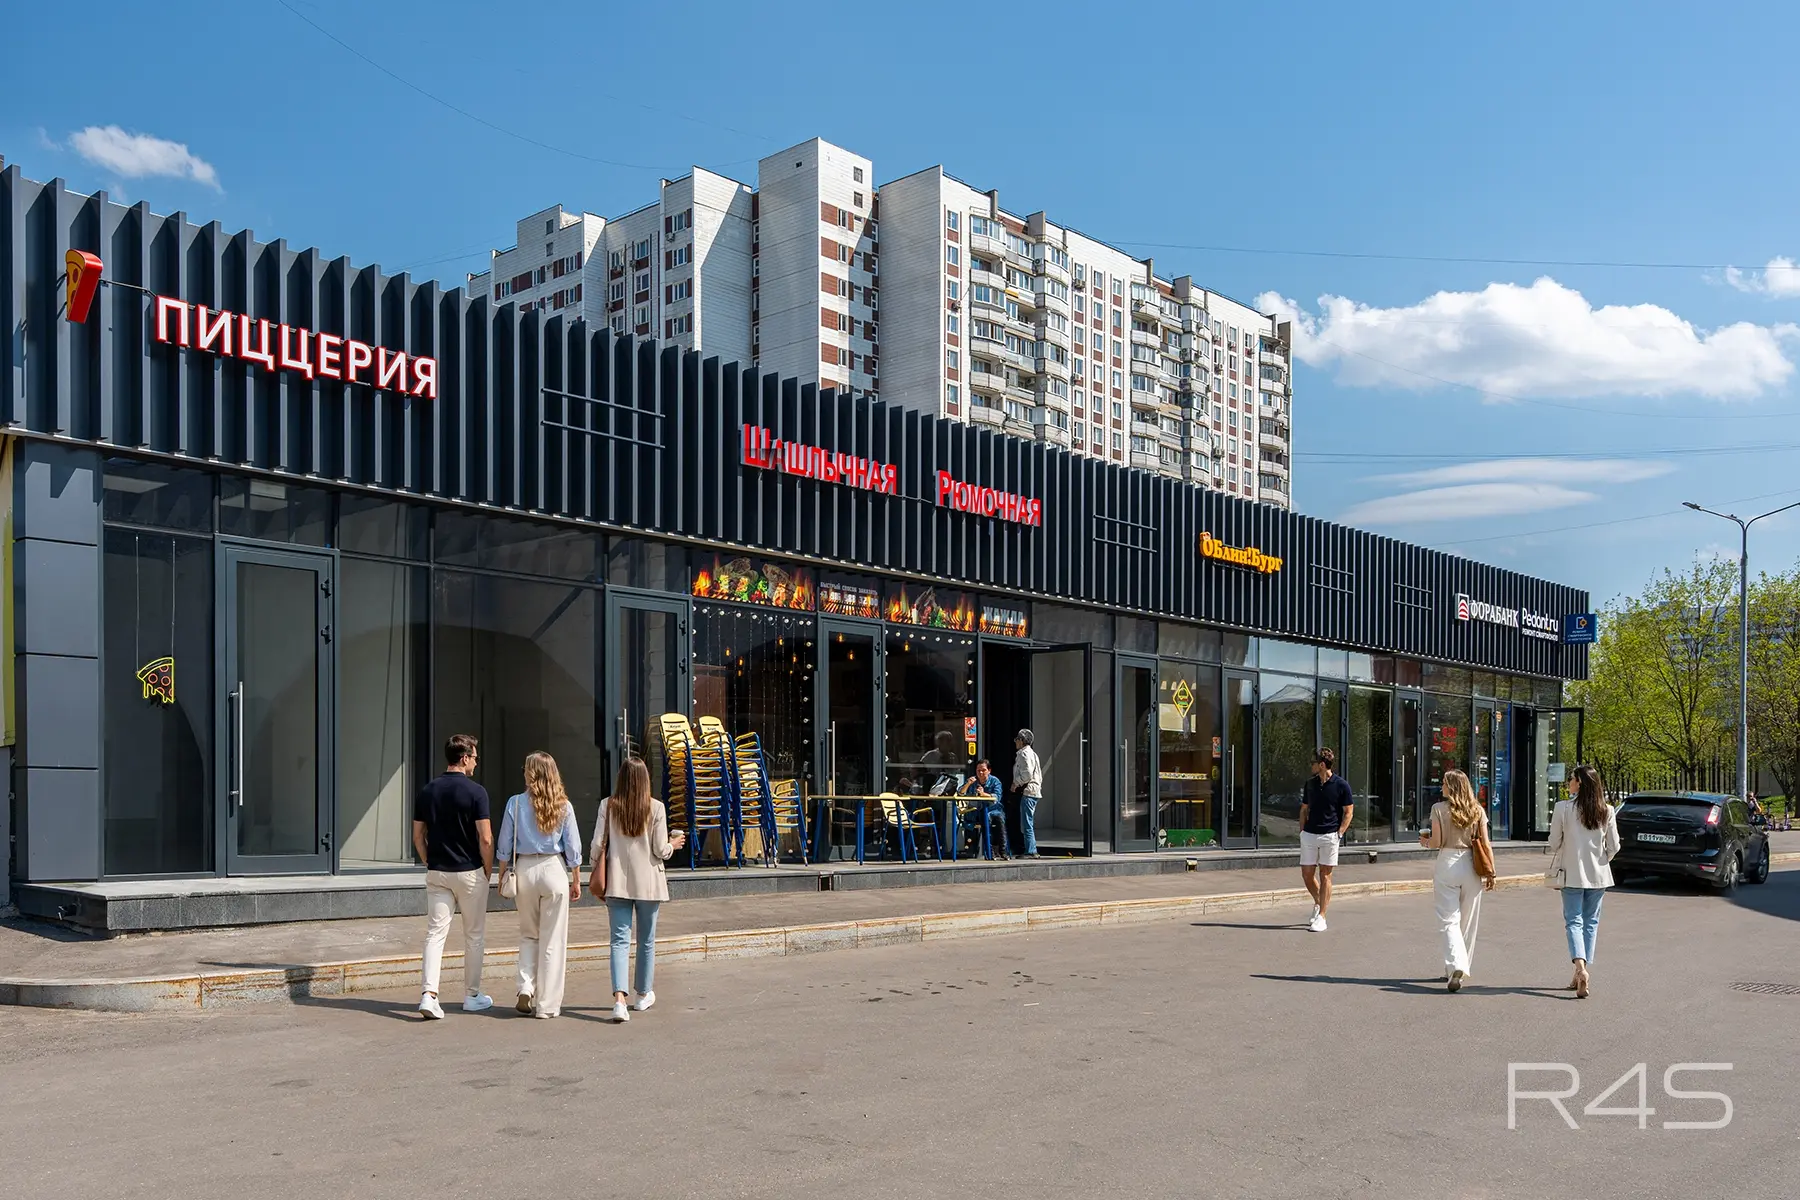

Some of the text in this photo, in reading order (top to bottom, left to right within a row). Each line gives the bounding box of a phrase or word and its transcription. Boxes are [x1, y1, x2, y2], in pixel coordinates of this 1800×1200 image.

[155, 295, 437, 399] ПИЦЦЕРИЯ
[983, 605, 1024, 625] ЖАЖДА
[1521, 607, 1559, 633] Pedant.ru
